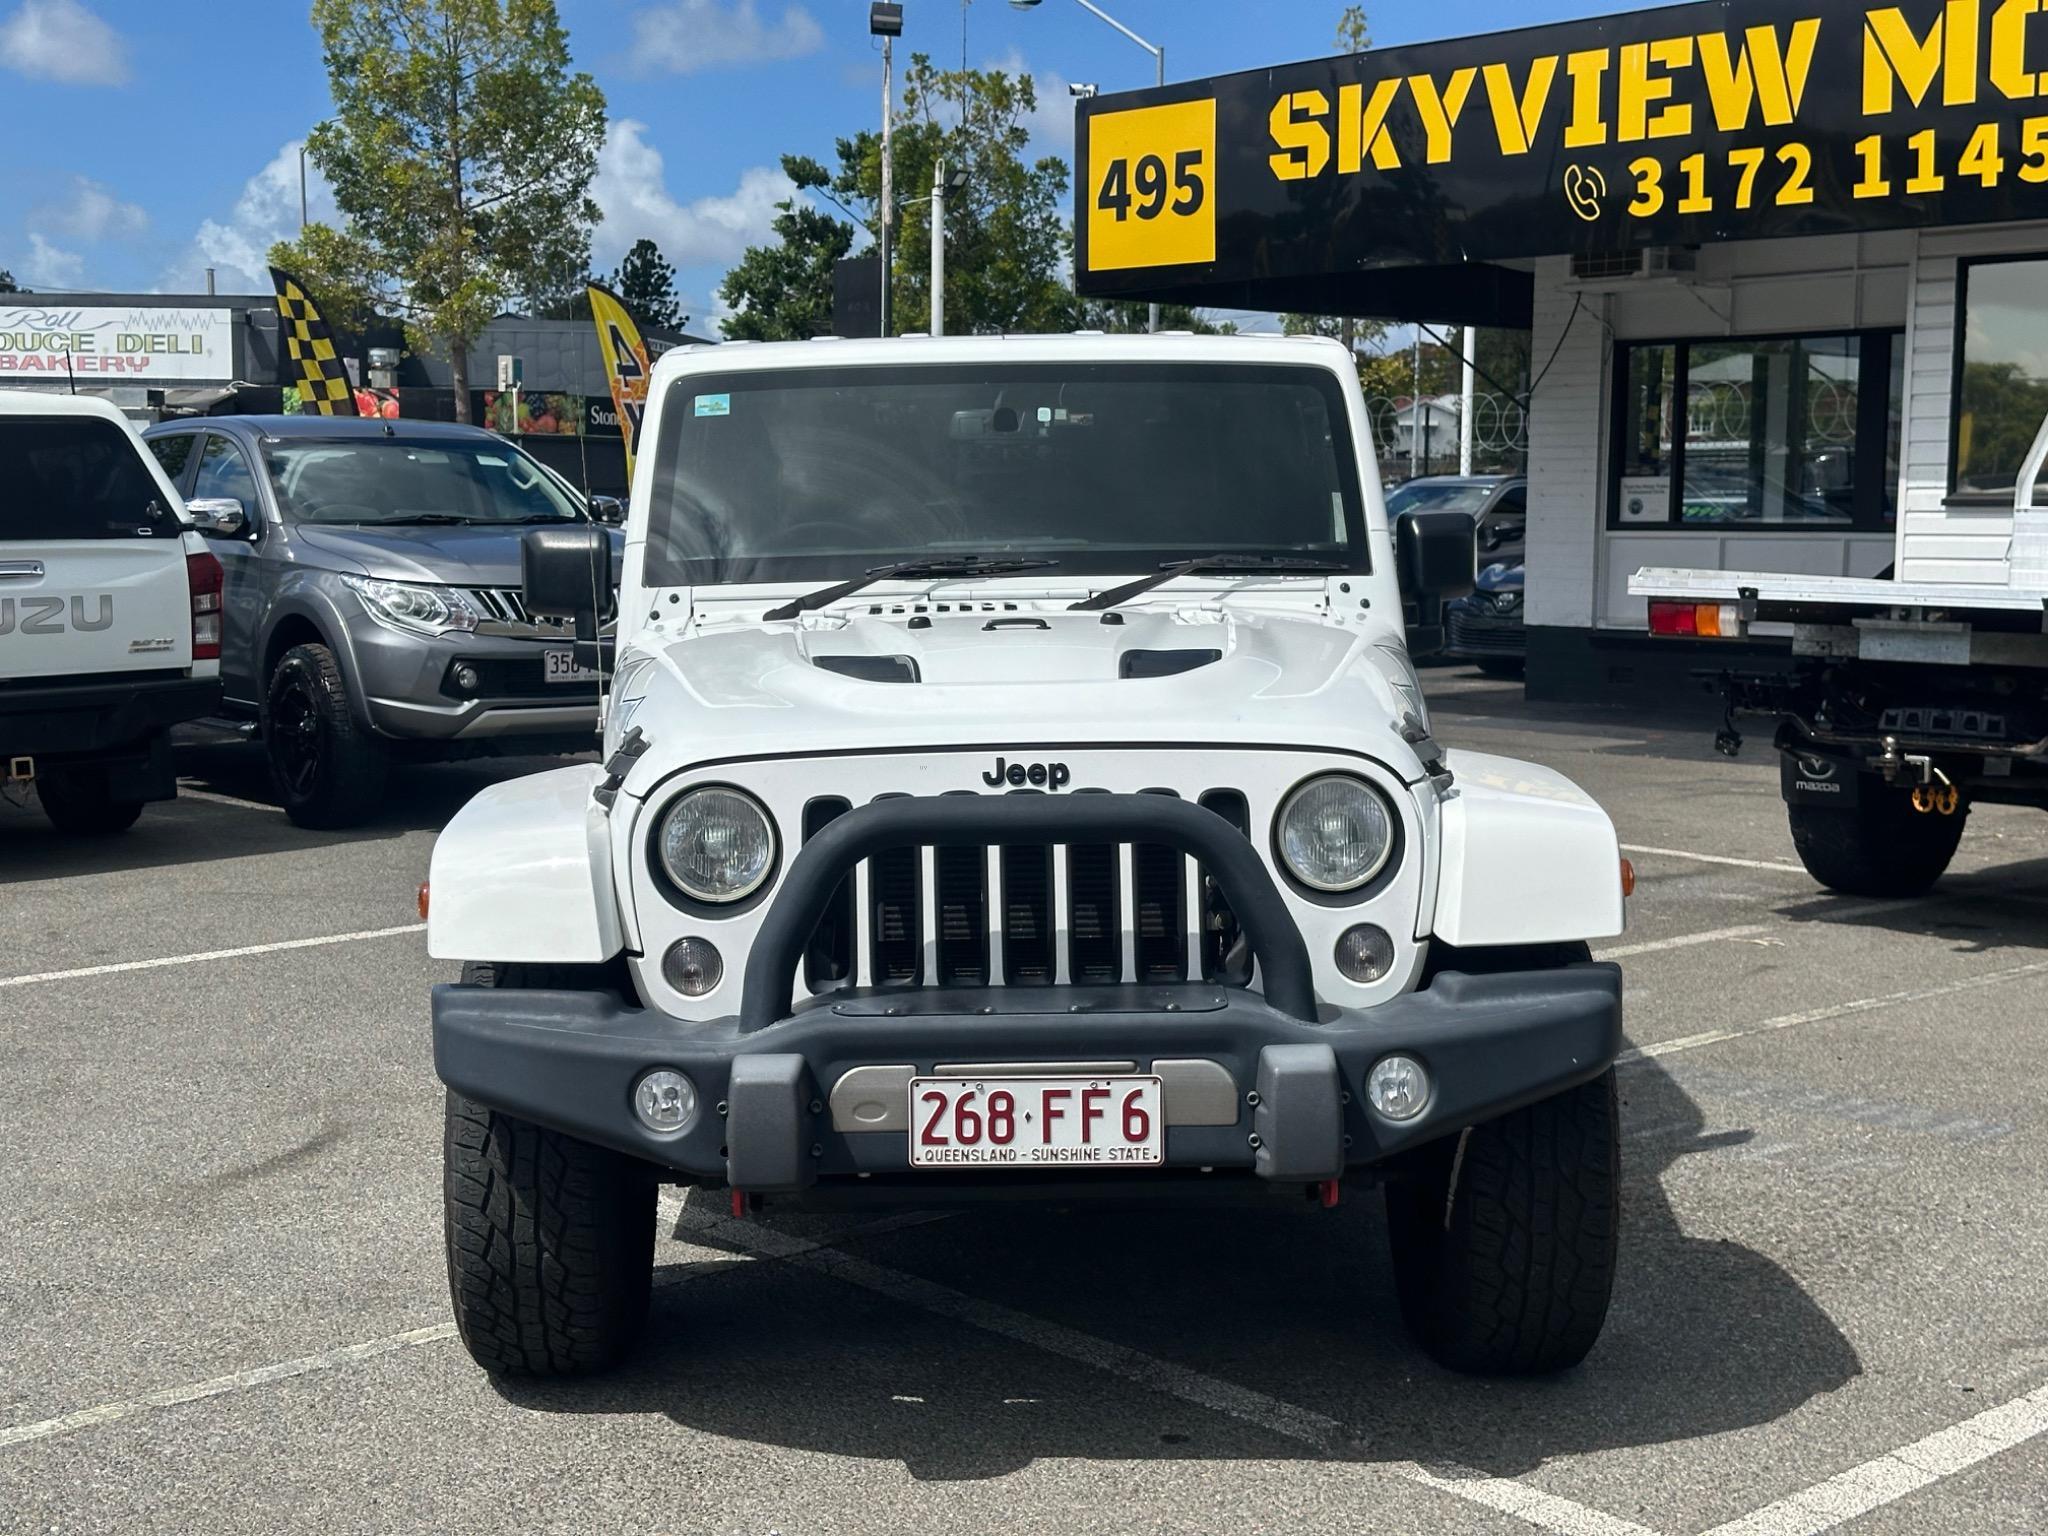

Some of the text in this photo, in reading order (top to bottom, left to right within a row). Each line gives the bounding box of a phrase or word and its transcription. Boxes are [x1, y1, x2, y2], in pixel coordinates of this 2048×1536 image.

[1269, 17, 1821, 181] SKYVIEW
[1098, 149, 1205, 222] 495
[1627, 116, 2048, 218] 3172 1145
[982, 757, 1069, 791] Jeep
[1796, 781, 1840, 792] mazda
[925, 1148, 1017, 1162] QUEENSLAND
[1031, 1147, 1101, 1162] SUNSHINE
[1108, 1147, 1150, 1161] STATE
